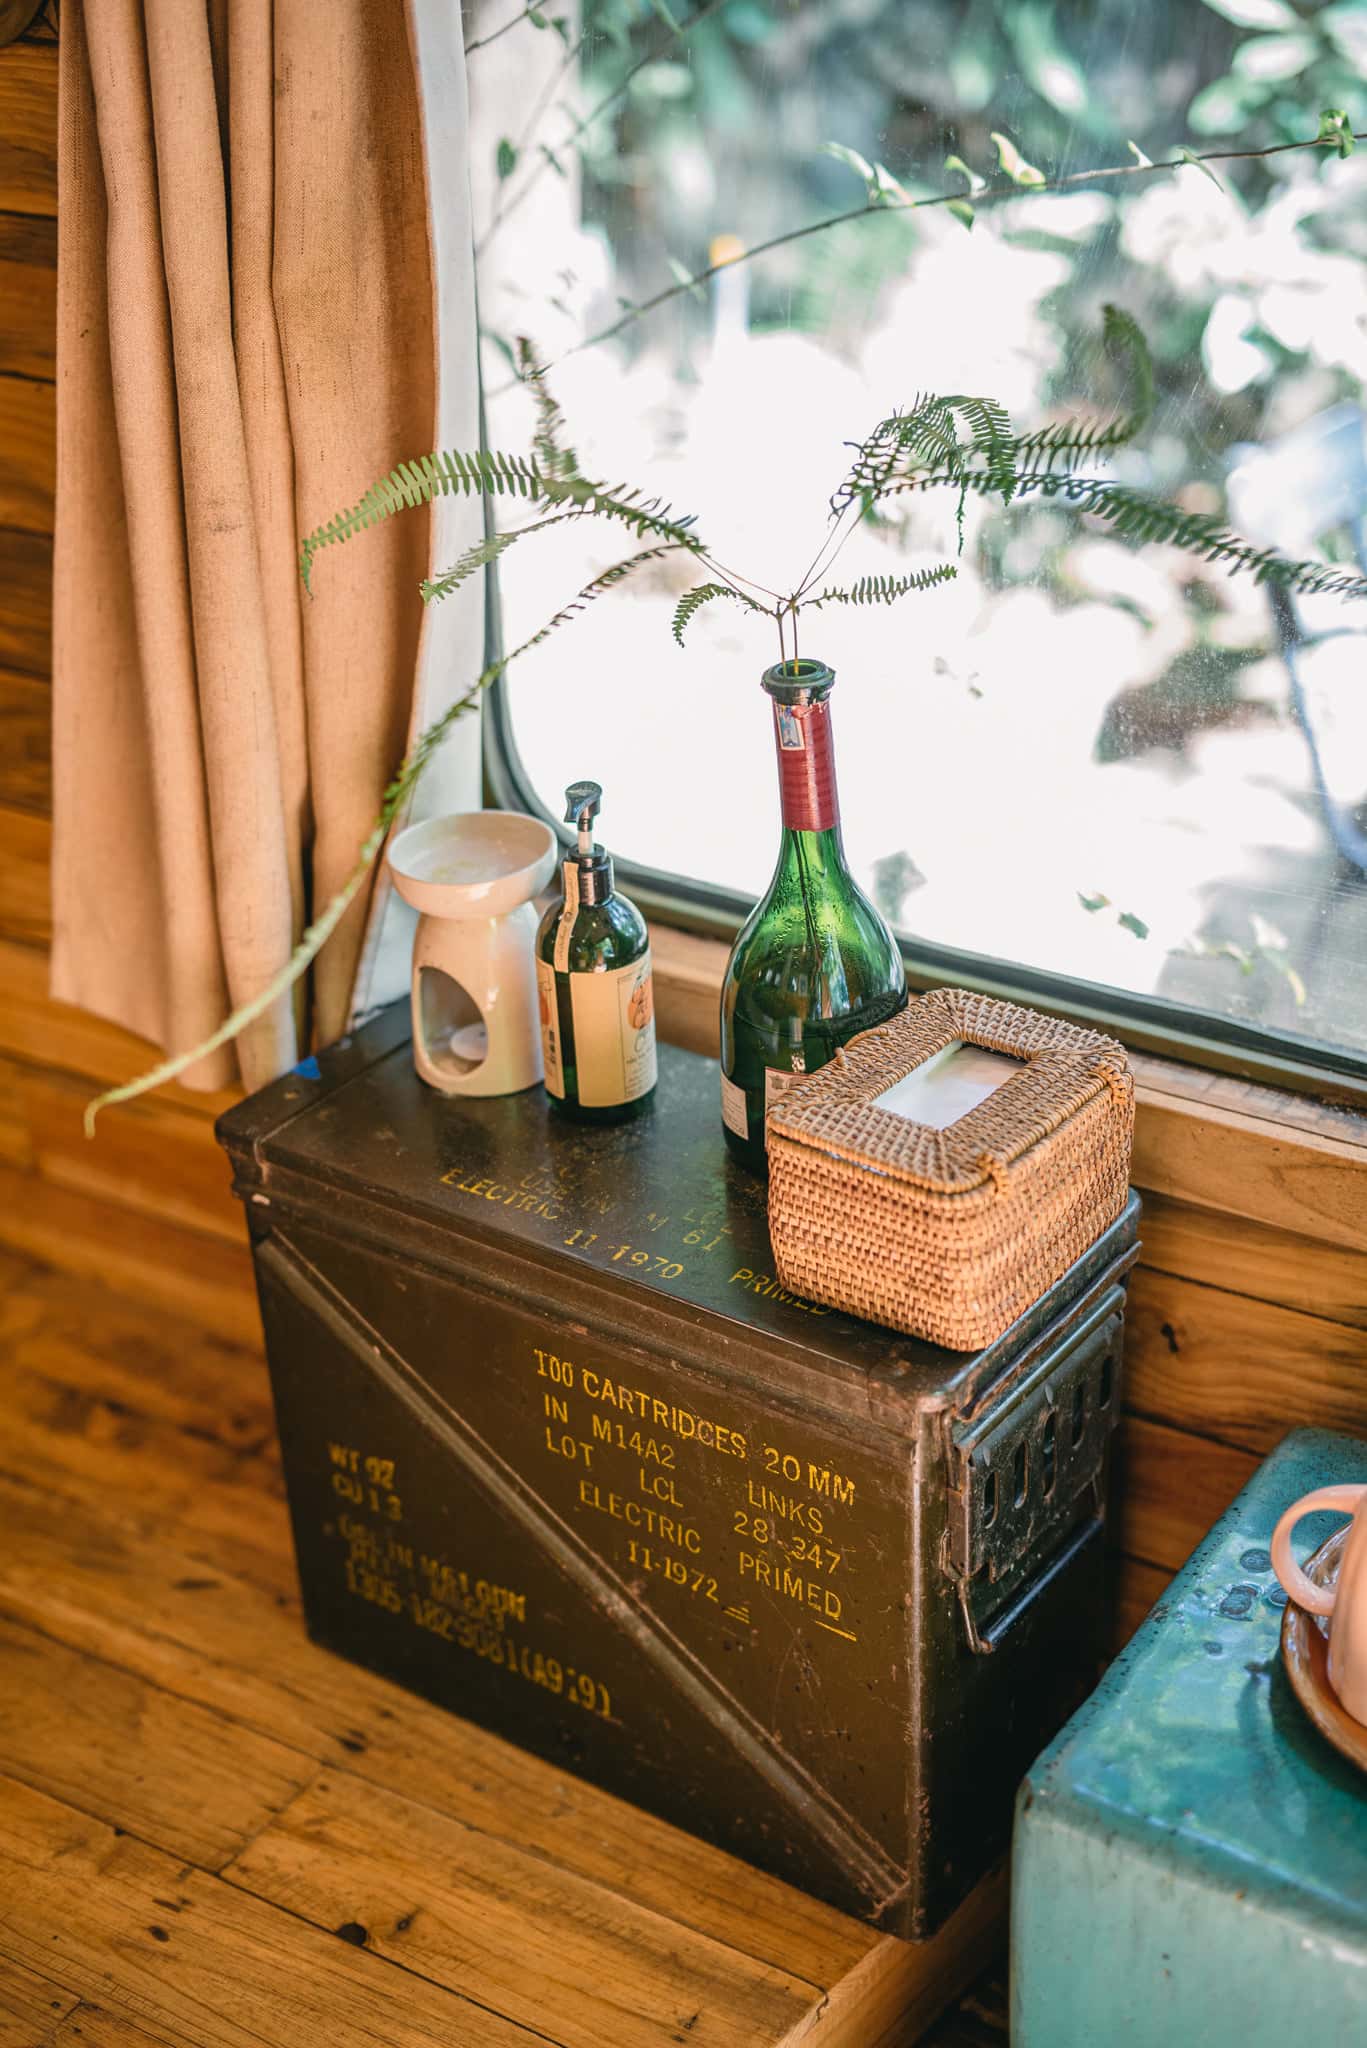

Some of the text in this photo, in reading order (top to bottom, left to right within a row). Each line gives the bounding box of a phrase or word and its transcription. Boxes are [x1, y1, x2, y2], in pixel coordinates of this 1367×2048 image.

[534, 1349, 574, 1388] 100
[582, 1369, 748, 1460] CARTRIDGES
[544, 1394, 824, 1535] IN M14A2 LINKS
[545, 1427, 595, 1467] LOT
[640, 1469, 684, 1508] LCL
[580, 1480, 843, 1620] ELECTRIC PRIMED
